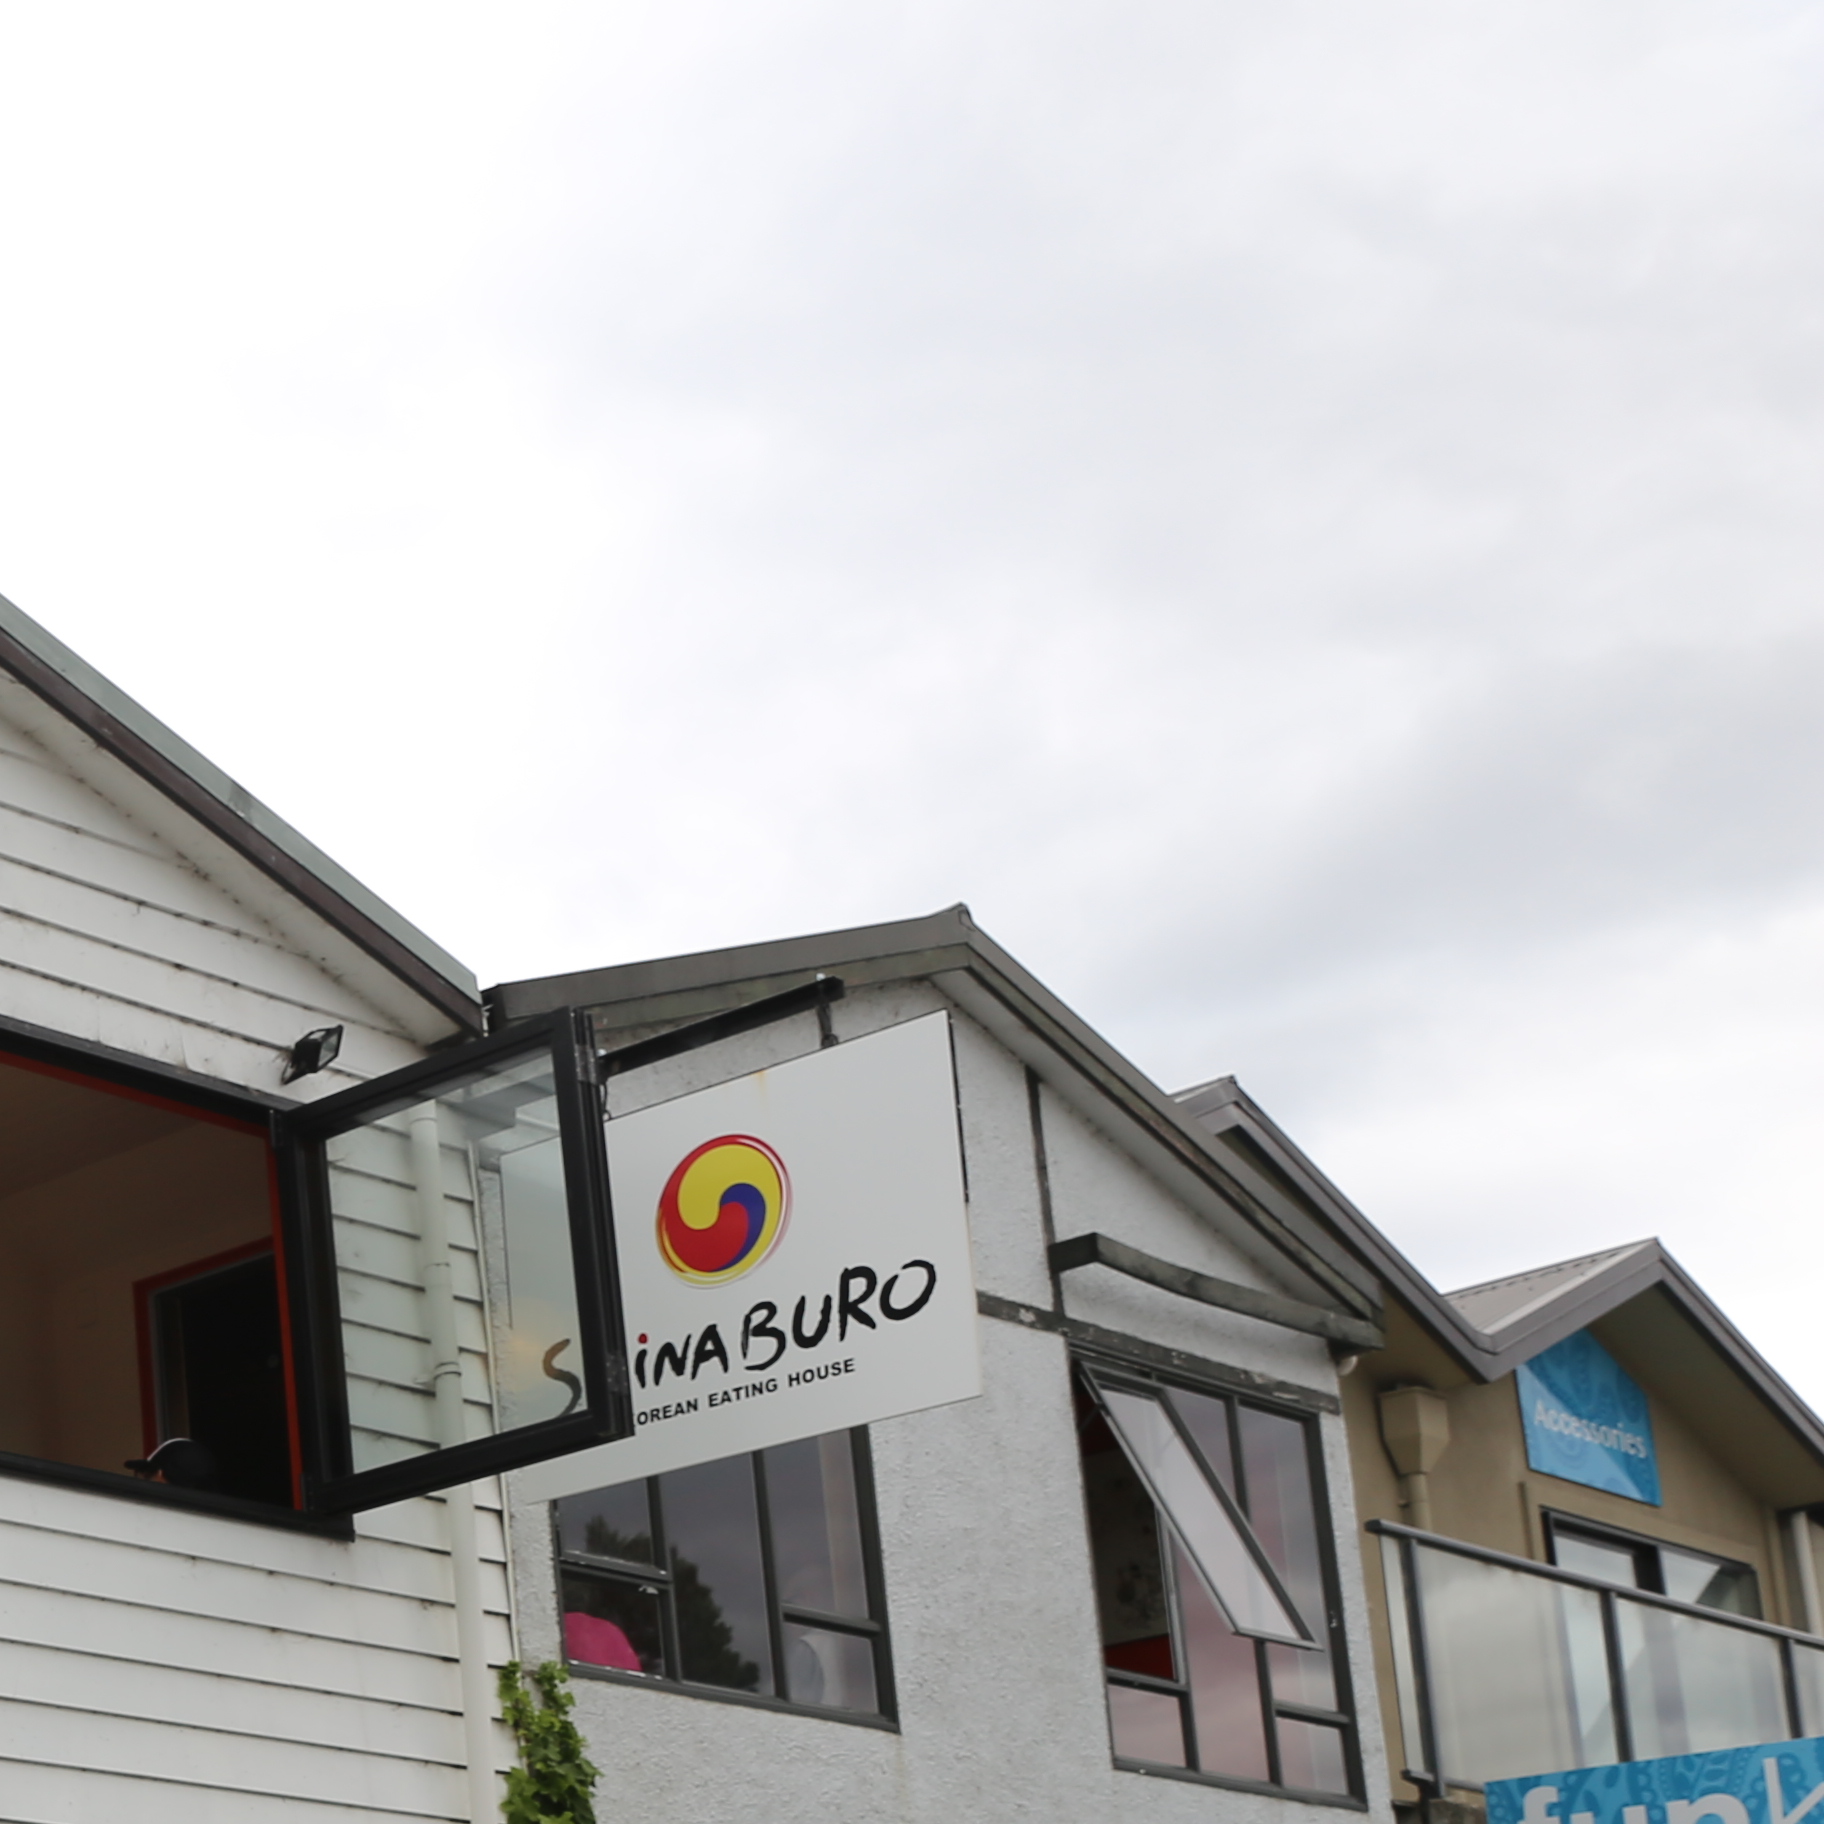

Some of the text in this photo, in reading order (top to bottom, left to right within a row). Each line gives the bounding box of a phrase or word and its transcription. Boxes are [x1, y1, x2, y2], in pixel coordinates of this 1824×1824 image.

[633, 1358, 854, 1428] OREAN EATING HOUSE
[1534, 1399, 1647, 1459] Accessories
